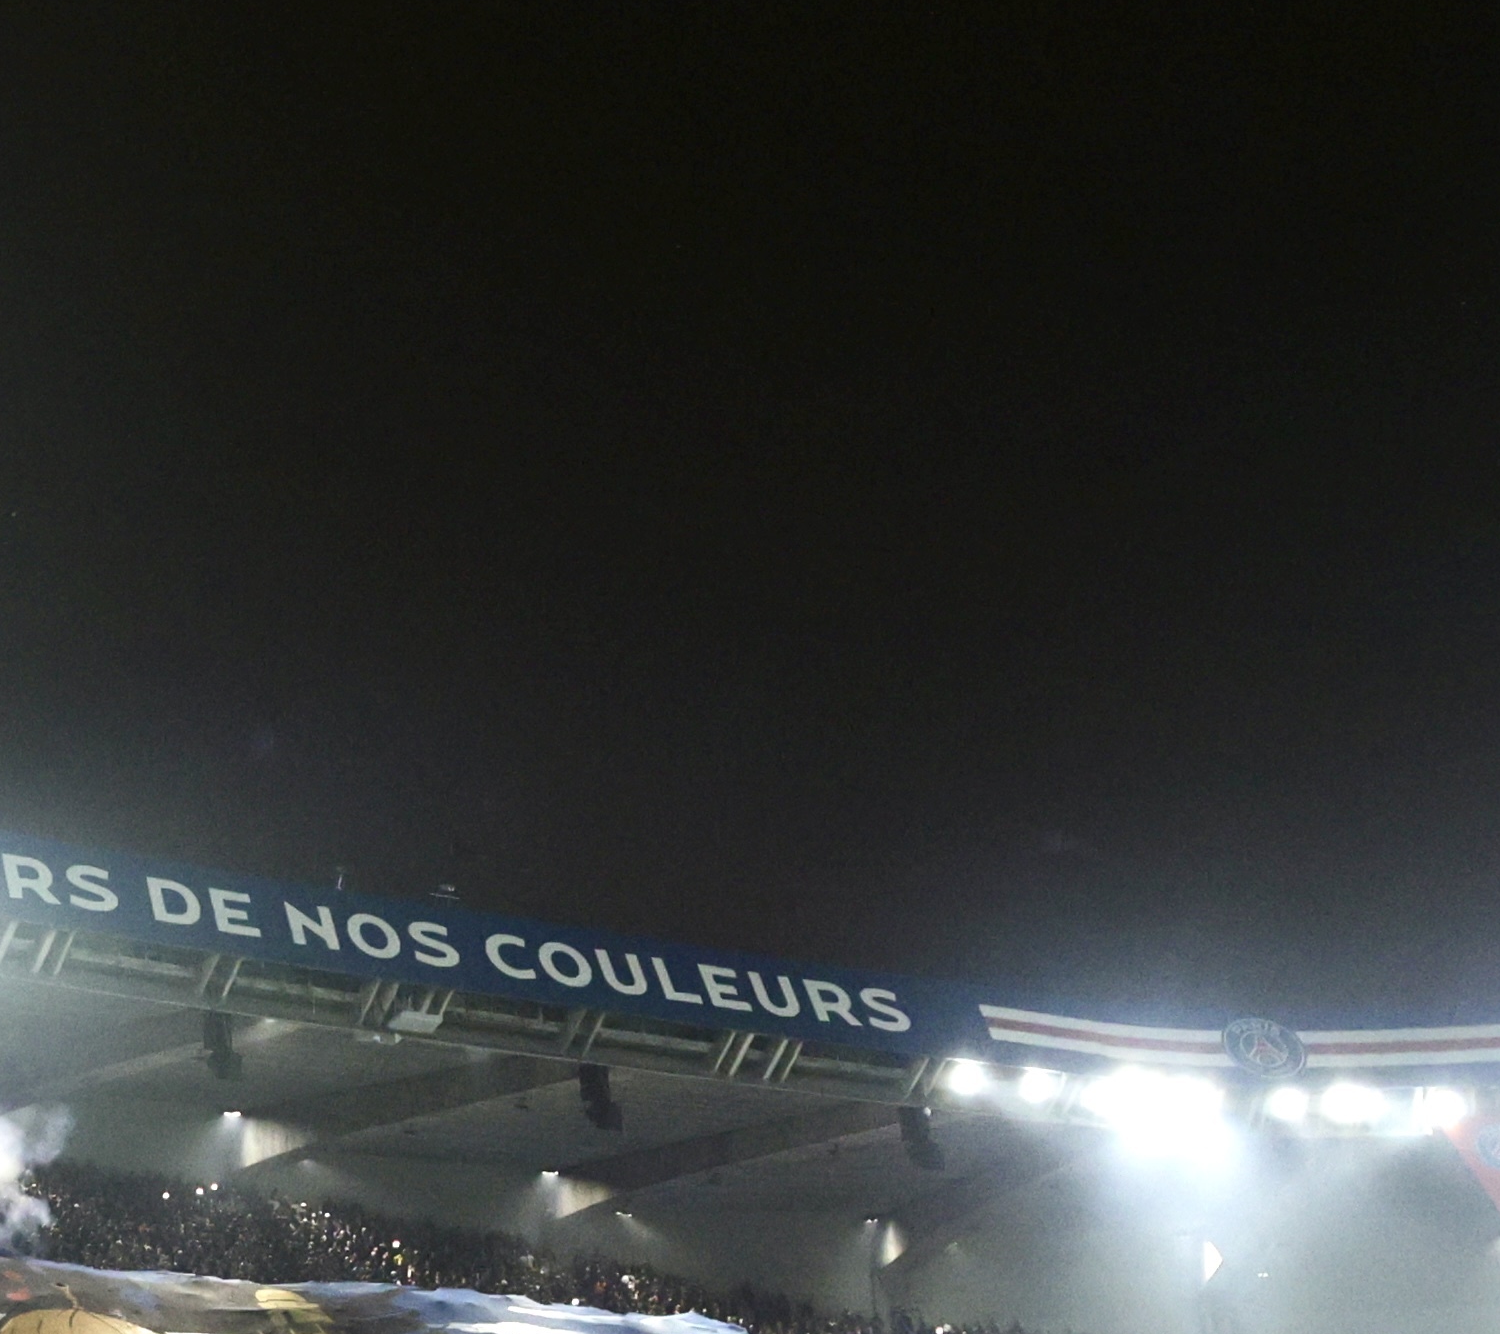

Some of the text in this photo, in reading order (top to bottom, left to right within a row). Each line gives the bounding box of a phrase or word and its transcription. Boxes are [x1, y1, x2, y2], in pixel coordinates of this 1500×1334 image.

[145, 875, 262, 938] DE
[283, 901, 461, 968] NOS
[484, 933, 912, 1034] COULEURS
